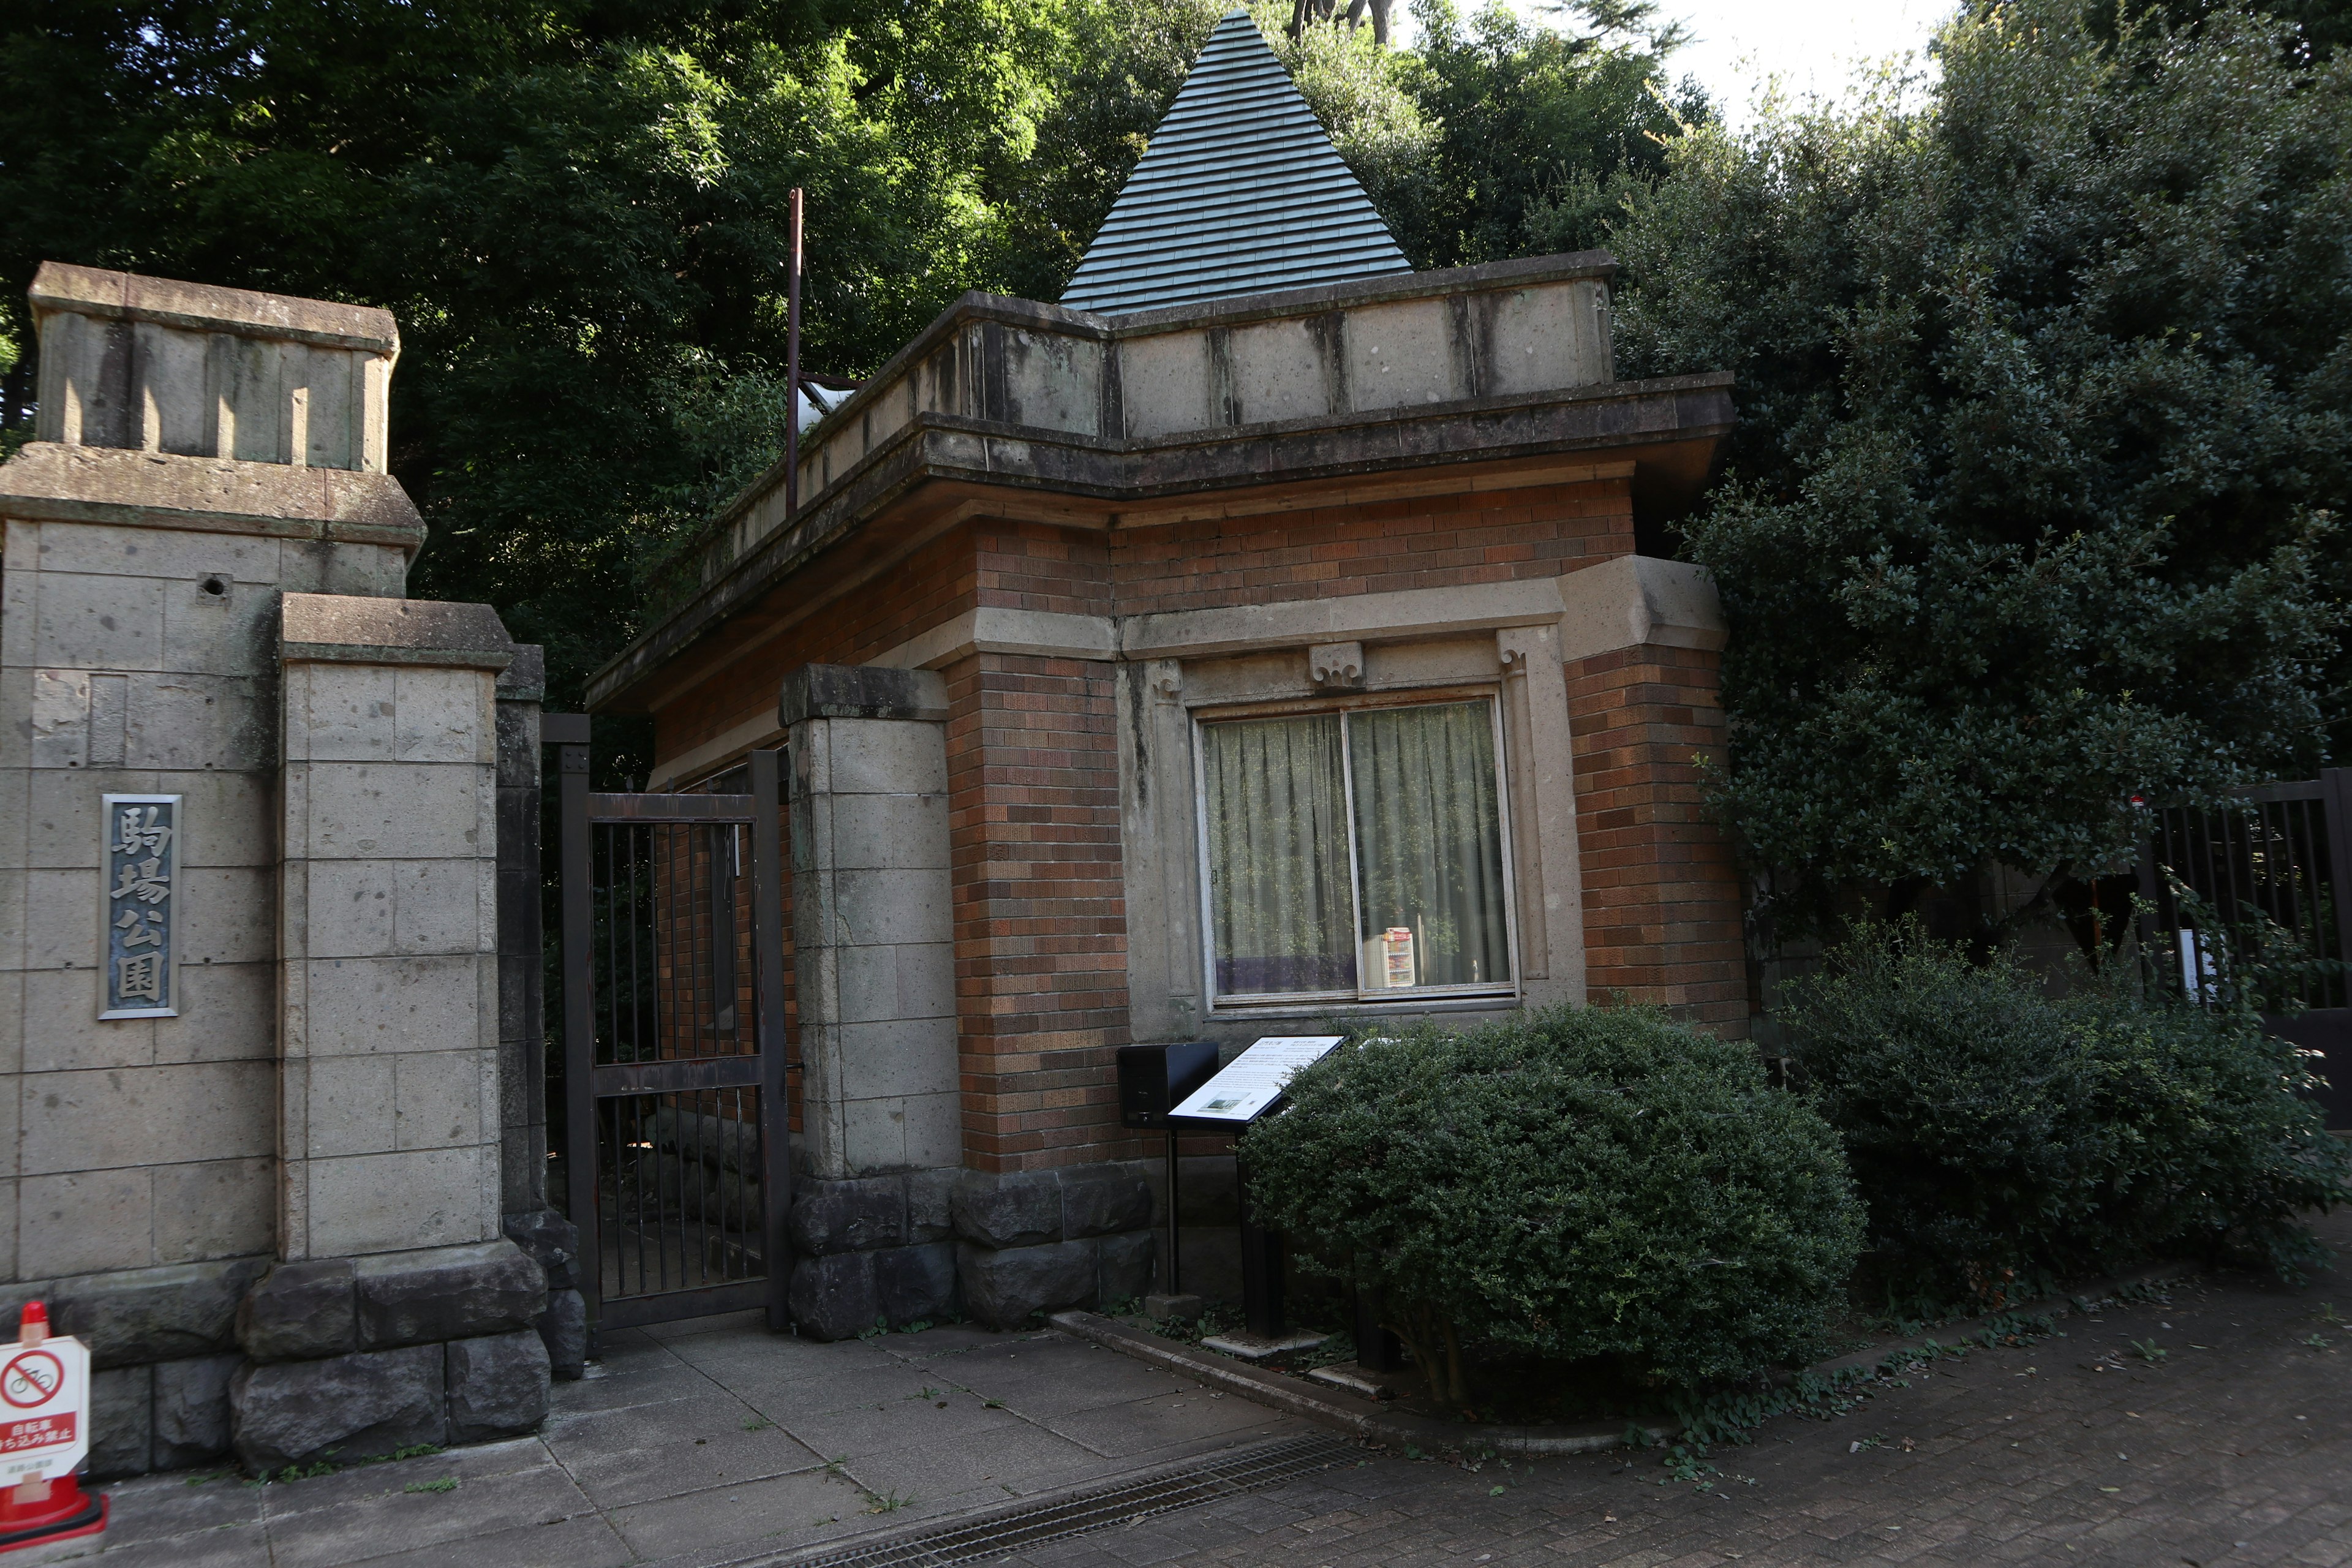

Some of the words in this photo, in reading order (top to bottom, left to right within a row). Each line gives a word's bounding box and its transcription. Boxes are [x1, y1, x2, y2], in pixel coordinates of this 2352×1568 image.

[111, 806, 172, 1001] 駒場公園
[12, 1419, 53, 1436] 自転車
